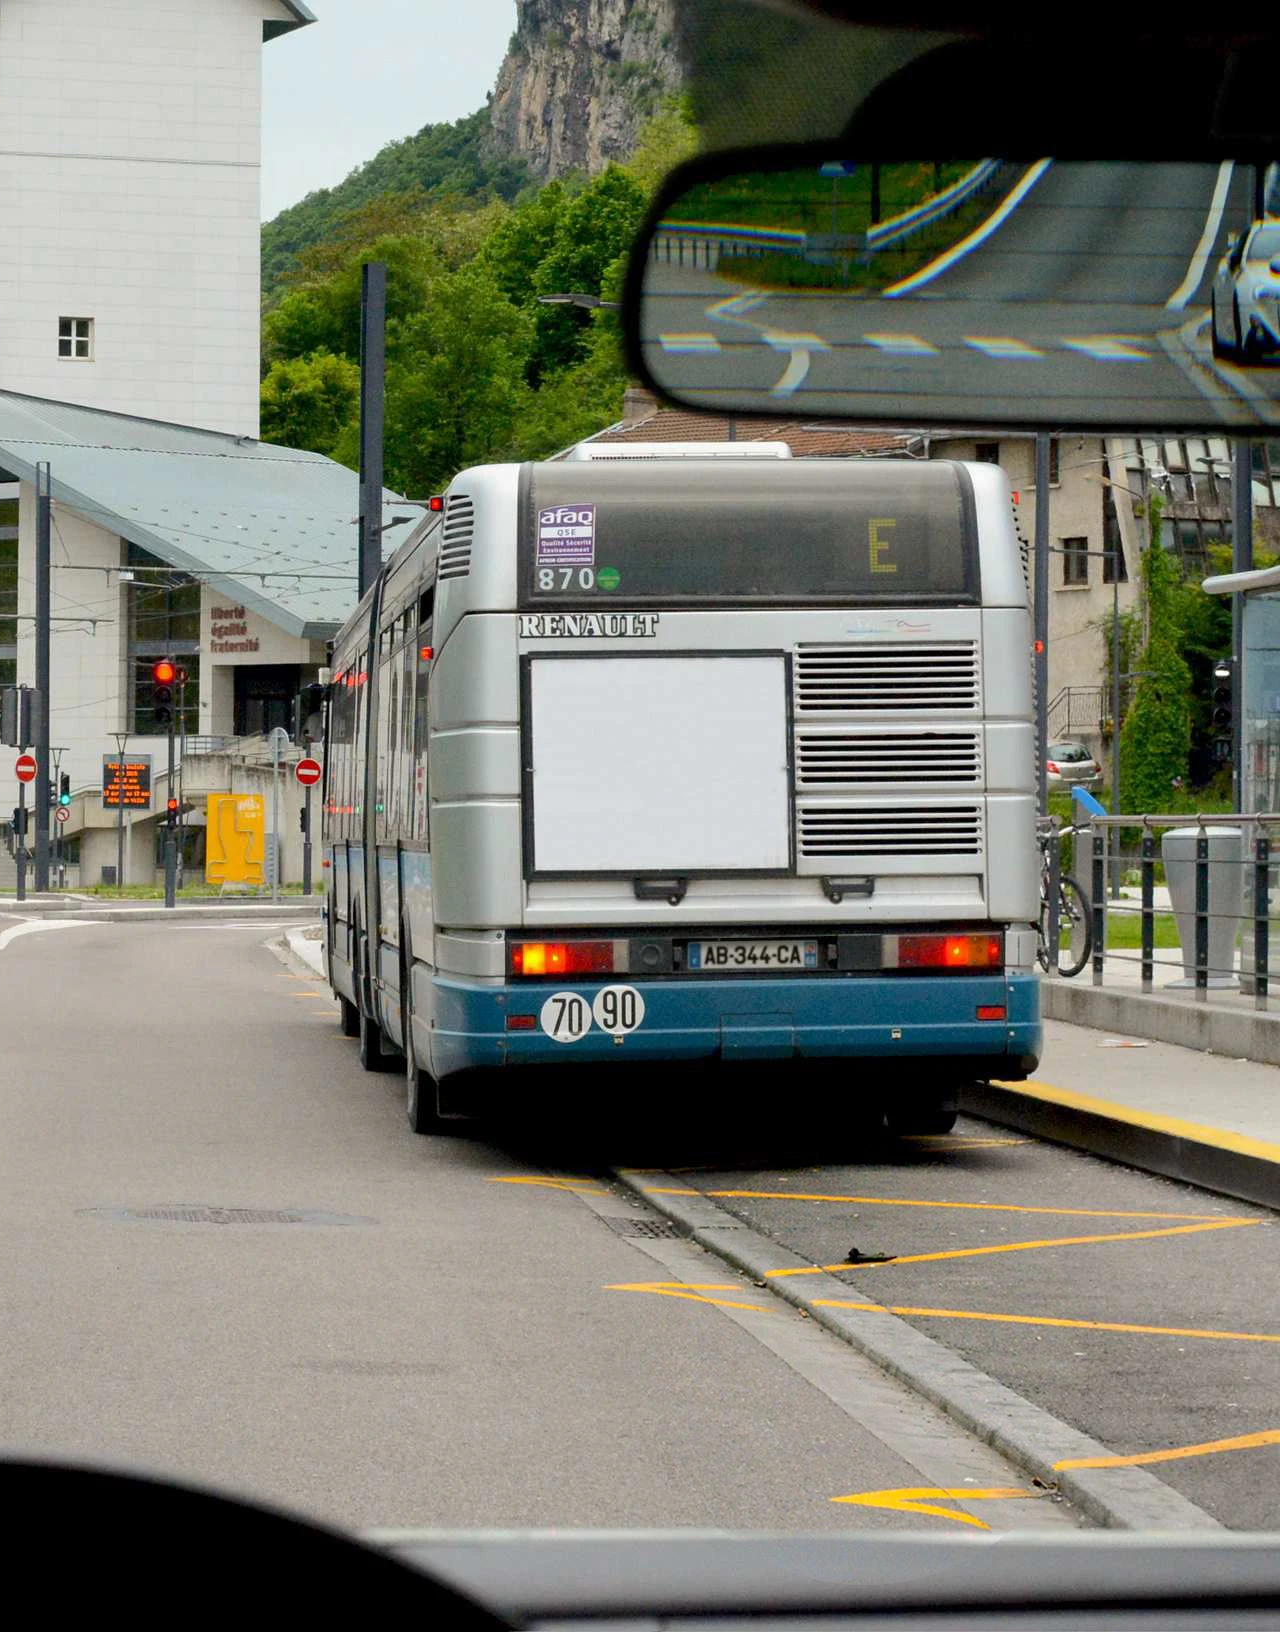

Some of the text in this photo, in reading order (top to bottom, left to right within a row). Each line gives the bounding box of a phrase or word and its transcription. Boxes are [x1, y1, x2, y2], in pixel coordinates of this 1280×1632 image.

[556, 528, 578, 537] QSE
[869, 519, 897, 573] E
[539, 567, 594, 590] 870
[520, 614, 659, 638] RENAULT
[706, 944, 803, 965] AB-344-CA
[551, 998, 583, 1037] 70
[603, 990, 636, 1030] 90
